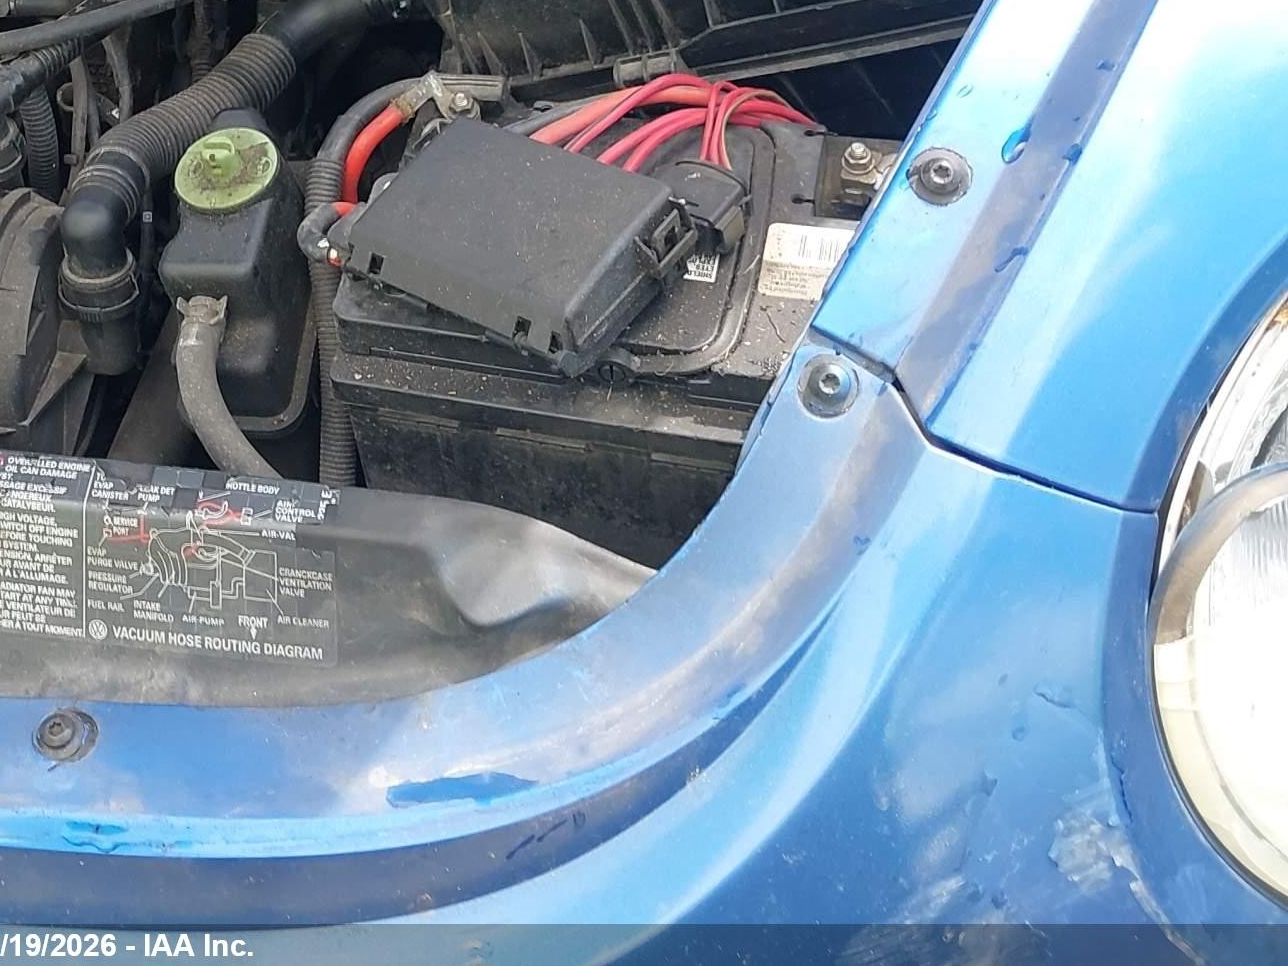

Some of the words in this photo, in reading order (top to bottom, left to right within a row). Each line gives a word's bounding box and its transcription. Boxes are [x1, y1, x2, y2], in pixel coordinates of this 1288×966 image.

[5, 464, 18, 473] OIL
[20, 467, 39, 476] CAN
[40, 468, 78, 479] DAMAGE
[58, 460, 91, 472] ENGINE
[94, 481, 114, 489] EVAP
[258, 483, 280, 495] BODY
[92, 489, 129, 500] CANISTER
[160, 487, 175, 496] DET
[137, 494, 160, 502] PUMP
[275, 513, 303, 523] VALVE
[276, 507, 316, 517] CONTROL
[18, 514, 57, 526] VOLTAGE,
[113, 516, 138, 527] SERVICE
[28, 524, 45, 532] OFF
[46, 526, 78, 538] ENGINE
[29, 533, 73, 547] TOUCHING
[13, 560, 41, 570] AVANT
[42, 564, 55, 573] DE
[87, 557, 113, 568] PURGE
[114, 560, 138, 570] VALVE
[88, 571, 127, 584] PRESSURE
[88, 580, 133, 594] REGULATOR
[278, 577, 332, 591] VENTILATION
[38, 585, 55, 596] FAN
[56, 588, 76, 598] MAY
[278, 586, 305, 598] VALVE
[22, 593, 33, 602] AT
[34, 594, 52, 604] ANY
[88, 599, 106, 610] FUEL
[6, 601, 62, 616] VENTILATEUR
[64, 608, 76, 618] DE
[134, 600, 161, 612] INTAKE
[12, 610, 34, 621] PEUT
[34, 614, 46, 623] SE
[133, 610, 174, 623] MANIFOLD
[238, 615, 268, 628] FRONT
[277, 615, 291, 625] AIR
[293, 617, 330, 629] CLEANER
[22, 622, 44, 632] TOUT
[113, 625, 166, 644] VACUUM
[169, 630, 202, 648] HOSE
[204, 636, 261, 654] ROUTING
[263, 642, 323, 660] DIAGRAM
